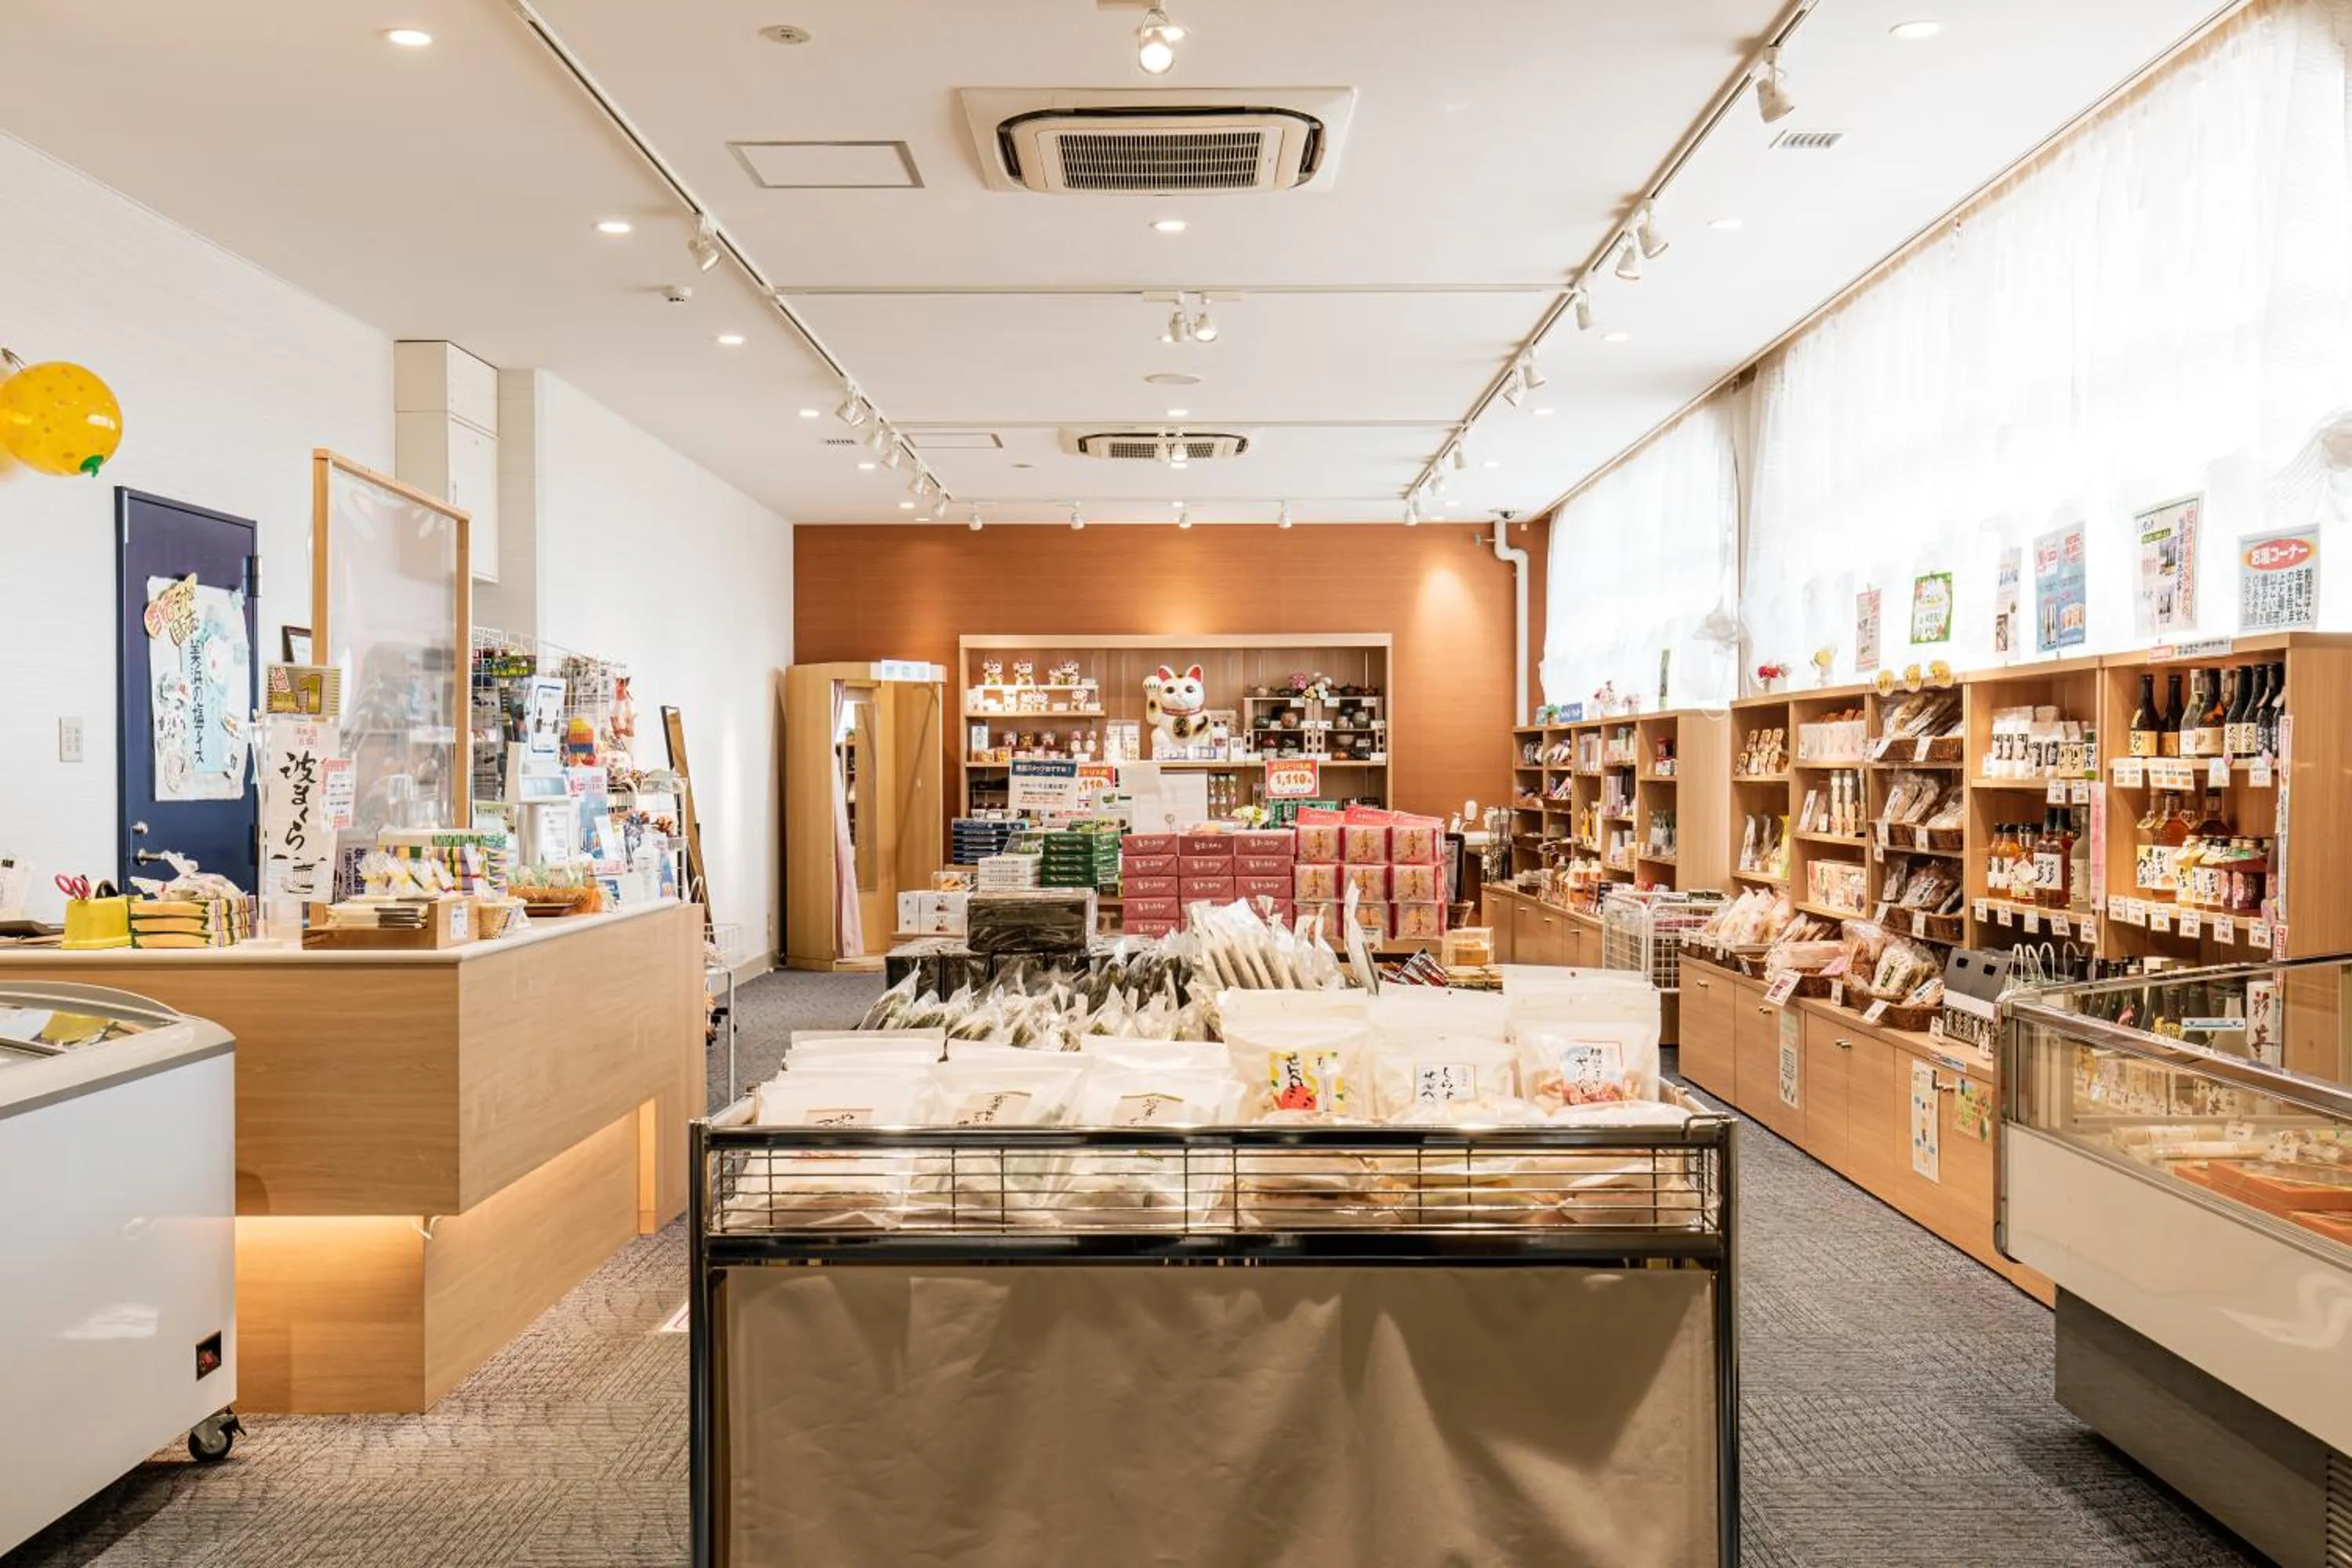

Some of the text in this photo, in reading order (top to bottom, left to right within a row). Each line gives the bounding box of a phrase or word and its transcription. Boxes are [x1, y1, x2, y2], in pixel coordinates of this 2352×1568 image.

[2251, 543, 2309, 565] お酒コーナー
[280, 750, 318, 851] 波まくら
